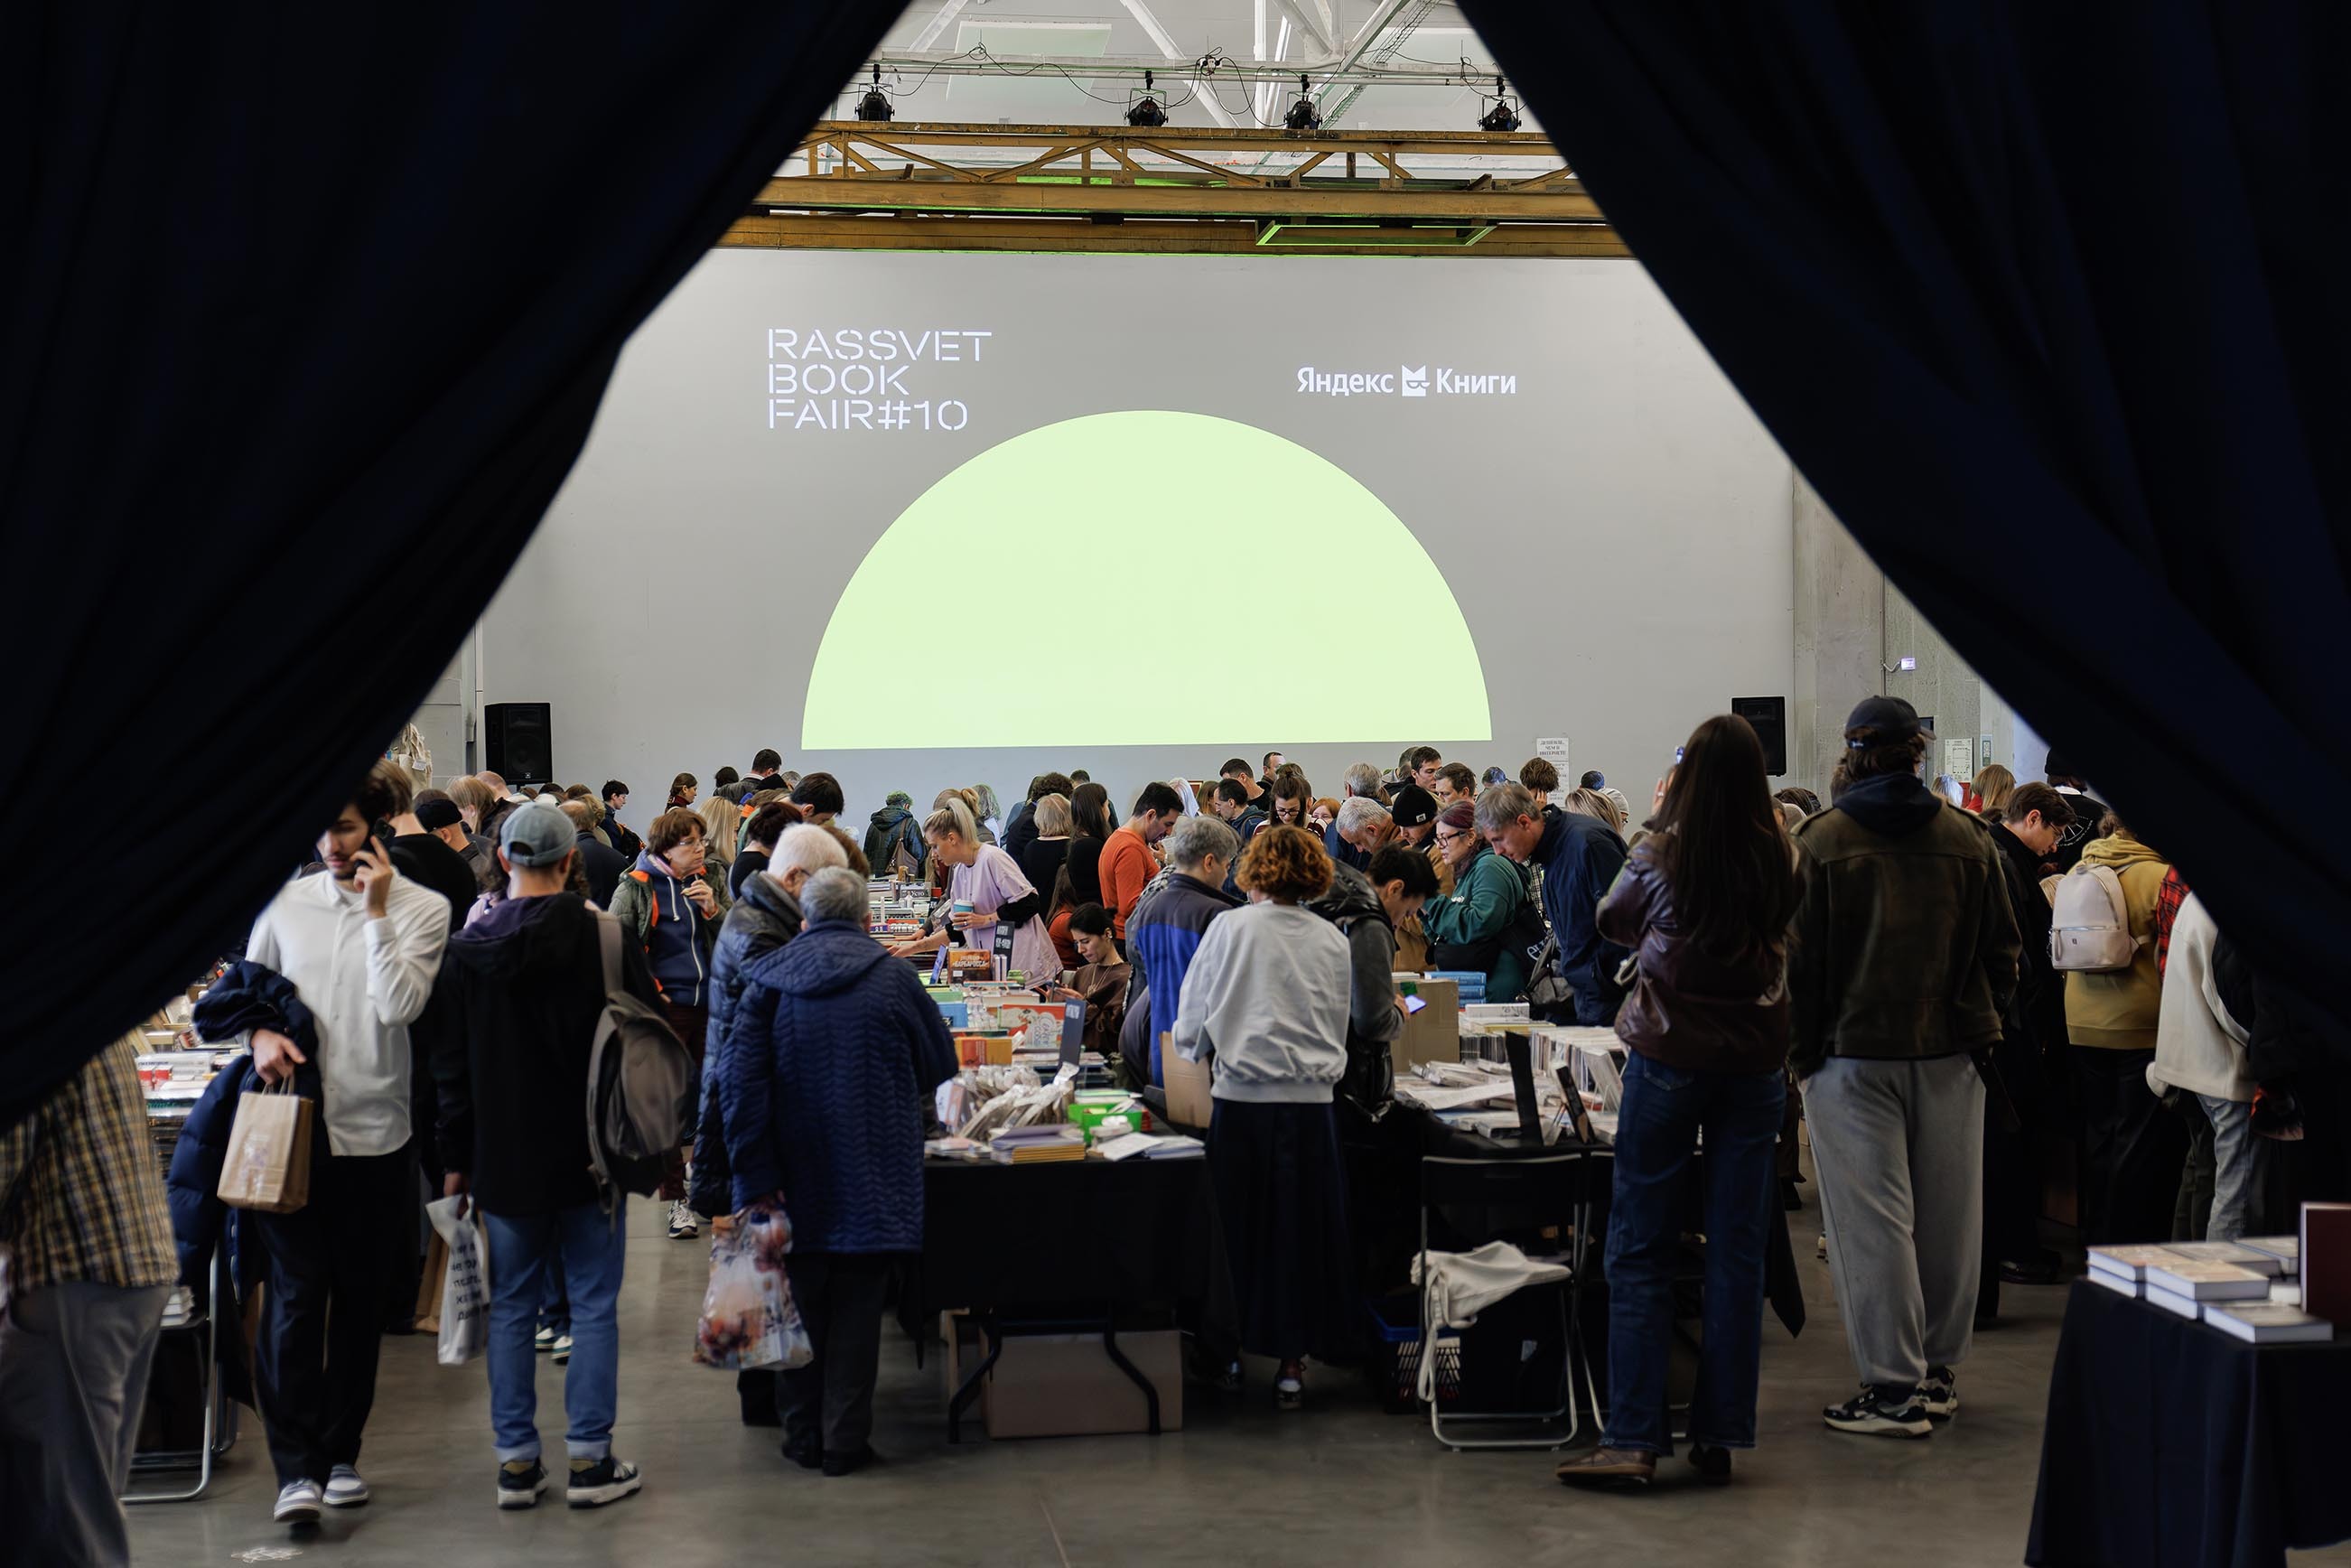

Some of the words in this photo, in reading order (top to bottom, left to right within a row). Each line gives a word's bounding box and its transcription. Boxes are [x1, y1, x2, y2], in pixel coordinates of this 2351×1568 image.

[768, 328, 993, 362] RASSVET
[768, 363, 910, 396] BOOK
[1296, 366, 1395, 397] Яндекс
[1436, 367, 1517, 395] Книги
[769, 398, 969, 432] FAIR#10
